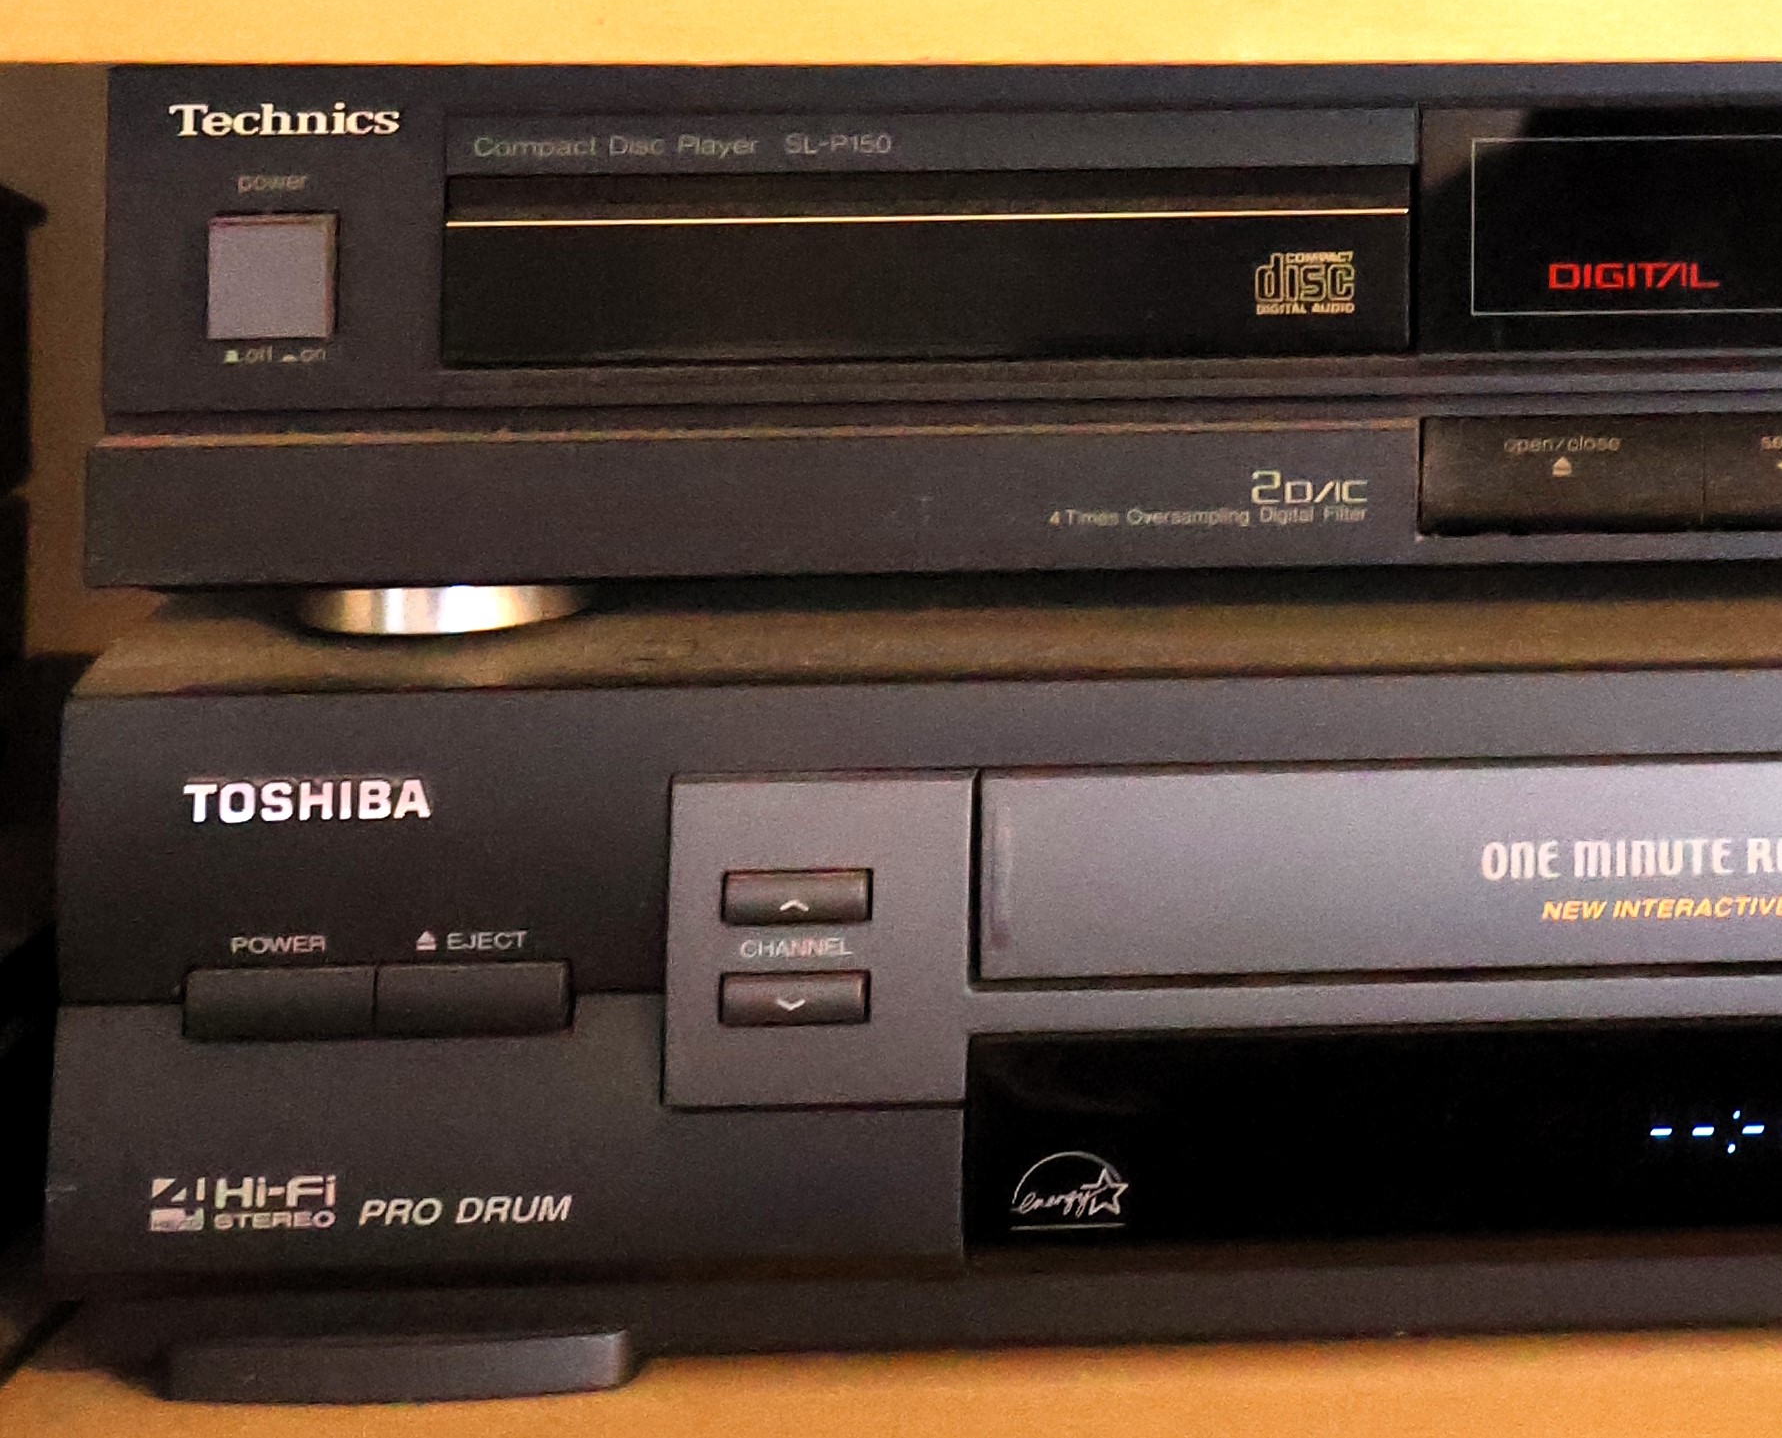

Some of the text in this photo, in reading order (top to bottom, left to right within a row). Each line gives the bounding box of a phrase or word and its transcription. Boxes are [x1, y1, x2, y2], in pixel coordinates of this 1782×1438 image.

[170, 102, 400, 138] Technics
[474, 133, 891, 161] Compact Disc Player SL-P150
[238, 172, 308, 194] power
[1285, 251, 1354, 263] COMPACT
[1255, 253, 1355, 303] disc
[1549, 262, 1719, 289] DIGITAL
[1256, 302, 1355, 315] DIGITAL AUDIO
[243, 345, 327, 363] off on
[1503, 435, 1621, 454] open/close
[1066, 509, 1119, 525] Times
[1127, 508, 1250, 528] Oversampling
[1260, 506, 1315, 525] Digital
[1324, 506, 1368, 522] Filter
[184, 779, 430, 823] TOSHIBA
[1481, 839, 1561, 882] ONE
[1573, 836, 1735, 879] MINUTE
[1541, 899, 1608, 921] NEW
[231, 935, 326, 955] POWER
[447, 931, 529, 951] EJECT
[740, 938, 853, 959] CHANNEL
[215, 1175, 337, 1209] Hi-Fi
[214, 1211, 336, 1231] STEREO
[358, 1194, 573, 1226] PRO DRUM
